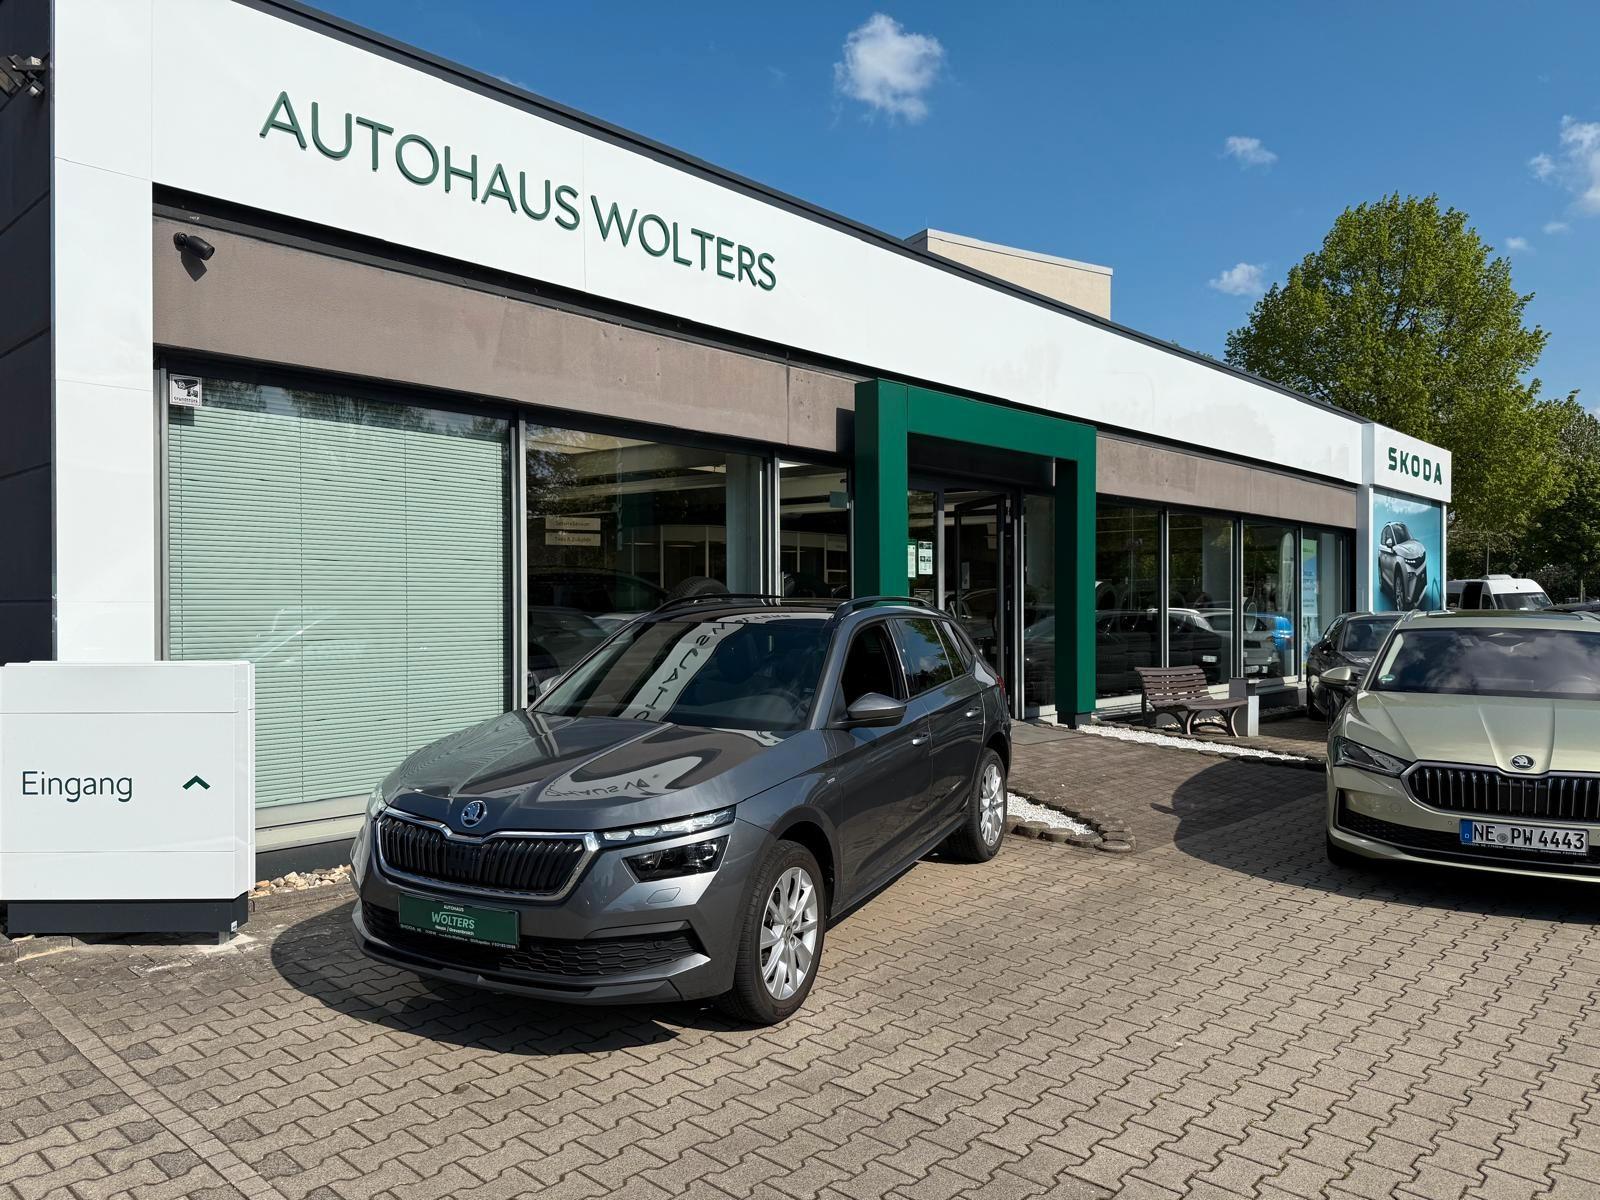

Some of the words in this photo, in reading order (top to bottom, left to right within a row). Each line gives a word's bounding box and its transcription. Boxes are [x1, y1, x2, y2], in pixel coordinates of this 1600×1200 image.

[258, 90, 581, 231] AUTOHAUS
[590, 194, 777, 292] WOLTERS
[22, 770, 133, 803] Eingang
[1473, 823, 1496, 842] NE
[1510, 827, 1534, 846] PW
[1538, 830, 1585, 850] 4443
[431, 911, 475, 929] WOLTERS
[443, 904, 465, 912] AUTOHAUS
